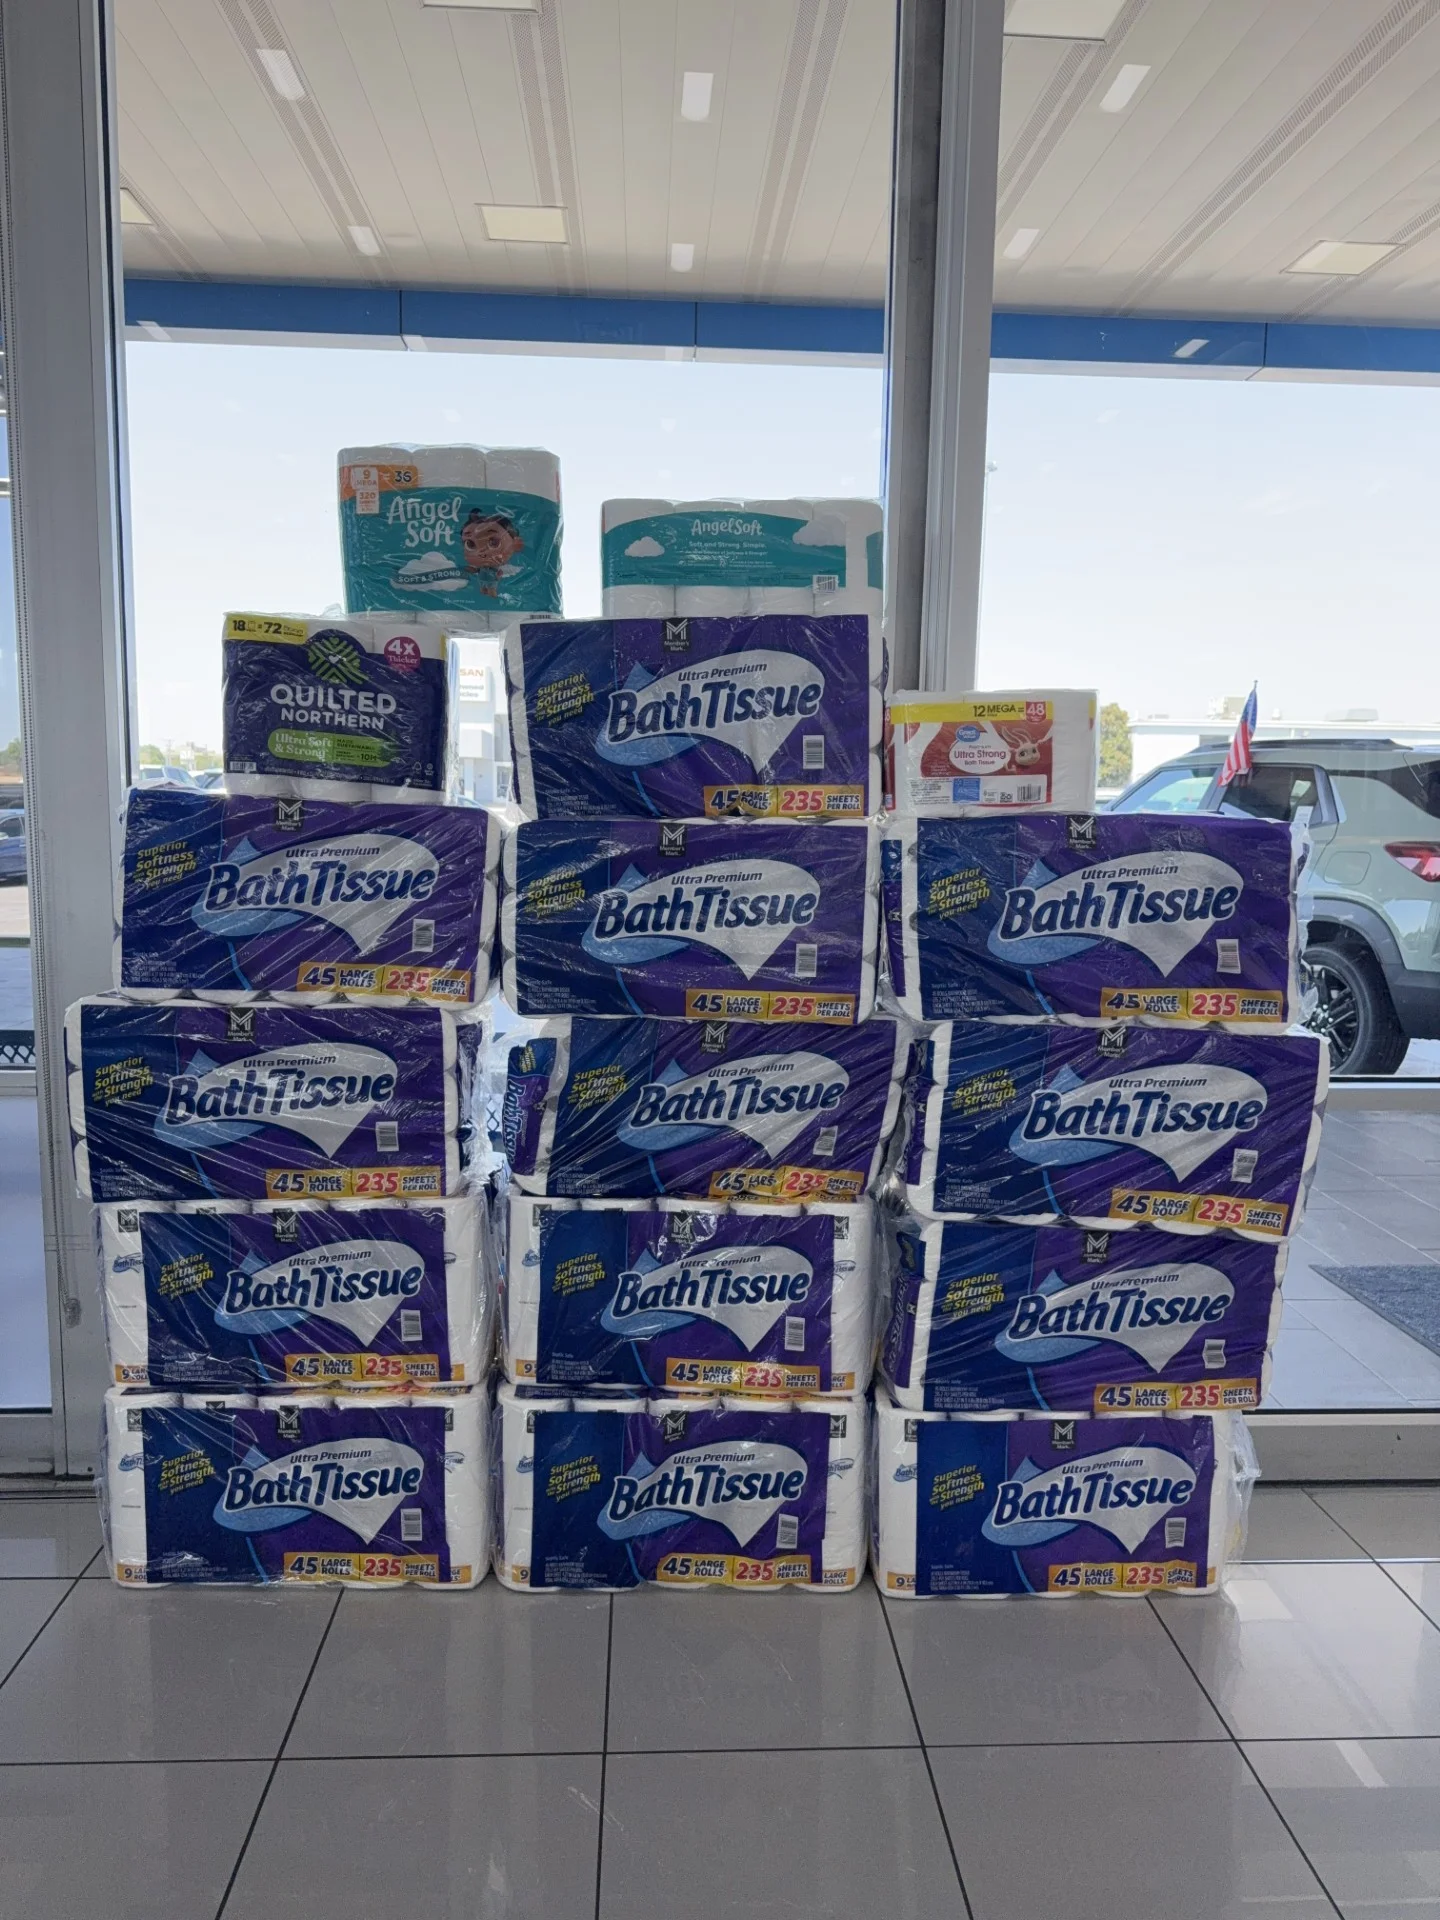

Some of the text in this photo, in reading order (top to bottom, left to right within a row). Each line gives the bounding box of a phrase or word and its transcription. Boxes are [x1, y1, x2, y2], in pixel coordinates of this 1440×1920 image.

[363, 470, 412, 482] 9 36
[387, 496, 461, 524] Angel
[405, 520, 455, 547] Soft
[428, 570, 460, 581] STRONG
[233, 620, 245, 631] 18
[264, 622, 282, 634] 72
[388, 655, 418, 663] Thicker
[678, 663, 767, 682] Ultra Premium
[271, 684, 396, 714] QUILTED
[282, 708, 384, 730] NORTHERN
[973, 703, 1044, 717] 12 MEGA 48
[275, 734, 331, 747] Ultra Soft
[287, 744, 326, 758] Strong
[954, 750, 1006, 759] Ultra Strong
[711, 789, 737, 810] 45
[783, 790, 860, 811] 235 SHEETS
[286, 847, 379, 858] Ultra Premium
[672, 872, 762, 885] Ultra Premium
[930, 868, 980, 889] Superior
[1081, 865, 1178, 880] Ultra Premium
[929, 878, 986, 900] Softness
[938, 887, 990, 910] Strength
[303, 968, 336, 985] 45
[386, 970, 429, 991] 235
[692, 994, 760, 1012] 45 LARGE
[771, 998, 814, 1015] 235
[1106, 993, 1177, 1009] 45 LARGE
[1191, 995, 1278, 1016] 235 SHEETS
[243, 1055, 336, 1068] Ultra Premium
[708, 1062, 794, 1078] Ultra Premium
[1109, 1077, 1207, 1088] Ultra Premium
[271, 1173, 304, 1192] 45
[356, 1172, 398, 1192] 235
[715, 1171, 745, 1190] 45
[785, 1172, 825, 1190] 235
[1116, 1195, 1149, 1213] 45
[1197, 1200, 1244, 1222] 235
[289, 1250, 371, 1267] Ultra Premium
[949, 1272, 998, 1290] Superior
[1091, 1273, 1179, 1291] Ultra Premium
[946, 1284, 1003, 1301] Softness
[953, 1292, 1004, 1310] Strength
[292, 1359, 353, 1376] 45 LARGE
[365, 1358, 401, 1376] 235
[671, 1363, 698, 1381] 45
[744, 1367, 782, 1388] 235
[1100, 1387, 1168, 1407] 45 LARGE
[1181, 1385, 1220, 1406] 235
[161, 1450, 204, 1470] Superior
[290, 1449, 371, 1463] Ultra Premium
[550, 1454, 593, 1475] Superior
[673, 1452, 755, 1464] Ultra Premium
[160, 1458, 210, 1479] Softness
[169, 1466, 214, 1486] Strength
[549, 1462, 598, 1485] Softness
[934, 1464, 976, 1484] Superior
[1062, 1459, 1143, 1475] Ultra Premium
[556, 1472, 600, 1495] Strength
[932, 1473, 981, 1495] Softness
[940, 1481, 985, 1502] Strength
[124, 1568, 132, 1579] 9
[289, 1557, 352, 1574] 45 LARGE
[364, 1558, 401, 1576] 235
[663, 1557, 724, 1574] 45 LARGE
[735, 1562, 807, 1581] 235 SHEETS
[792, 1570, 807, 1578] ROLL
[520, 1570, 528, 1580] 9
[1053, 1568, 1081, 1585] 45
[1126, 1567, 1164, 1584] 235
